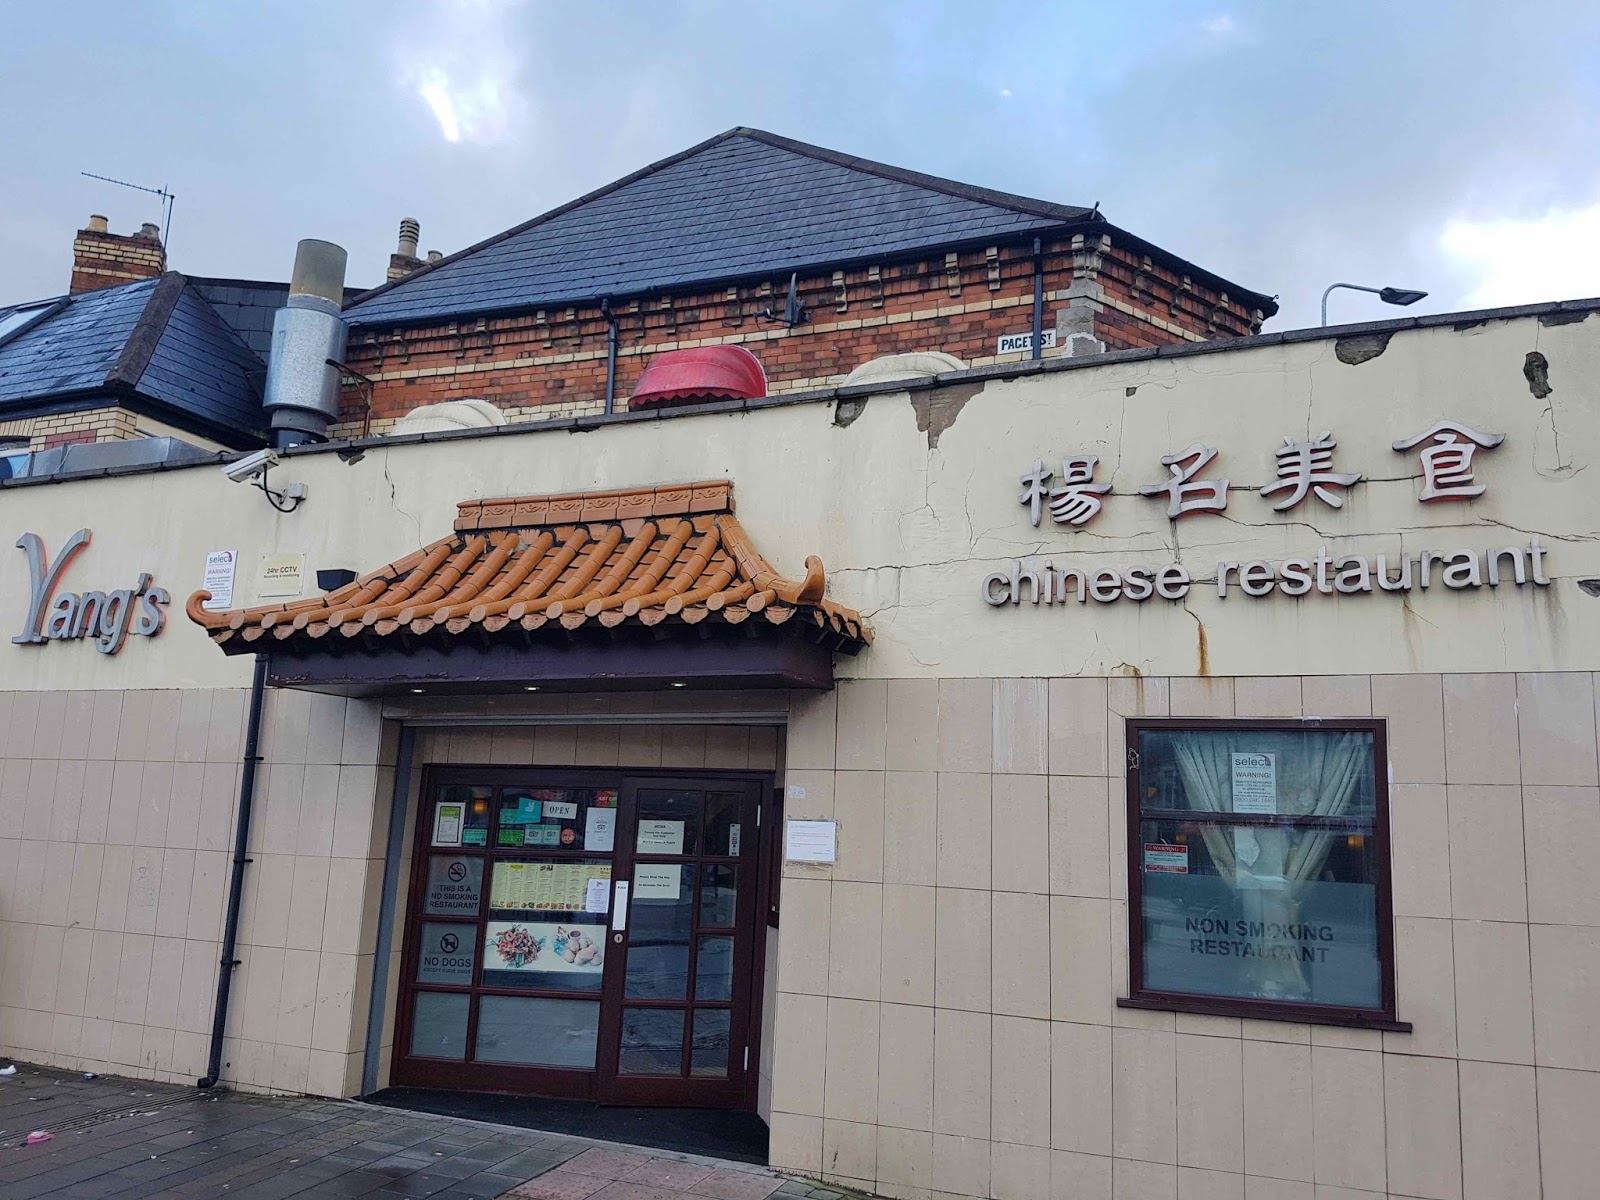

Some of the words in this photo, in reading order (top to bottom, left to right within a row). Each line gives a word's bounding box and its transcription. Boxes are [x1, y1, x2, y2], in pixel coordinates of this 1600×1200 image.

[1020, 420, 1507, 528] 楊名美食
[981, 558, 1190, 606] chinese
[1217, 537, 1552, 598] restaurant
[12, 528, 170, 655] Yang's
[549, 805, 571, 815] OPEN
[430, 892, 442, 900] NO
[443, 893, 478, 901] SMOKING
[439, 884, 456, 892] THIS
[429, 900, 479, 909] RESTAURANT
[1185, 917, 1229, 935] NON
[1235, 920, 1334, 942] SMOKING
[1190, 938, 1330, 963] RESTAURANT
[424, 956, 440, 966] NO
[441, 957, 472, 968] DOGS
